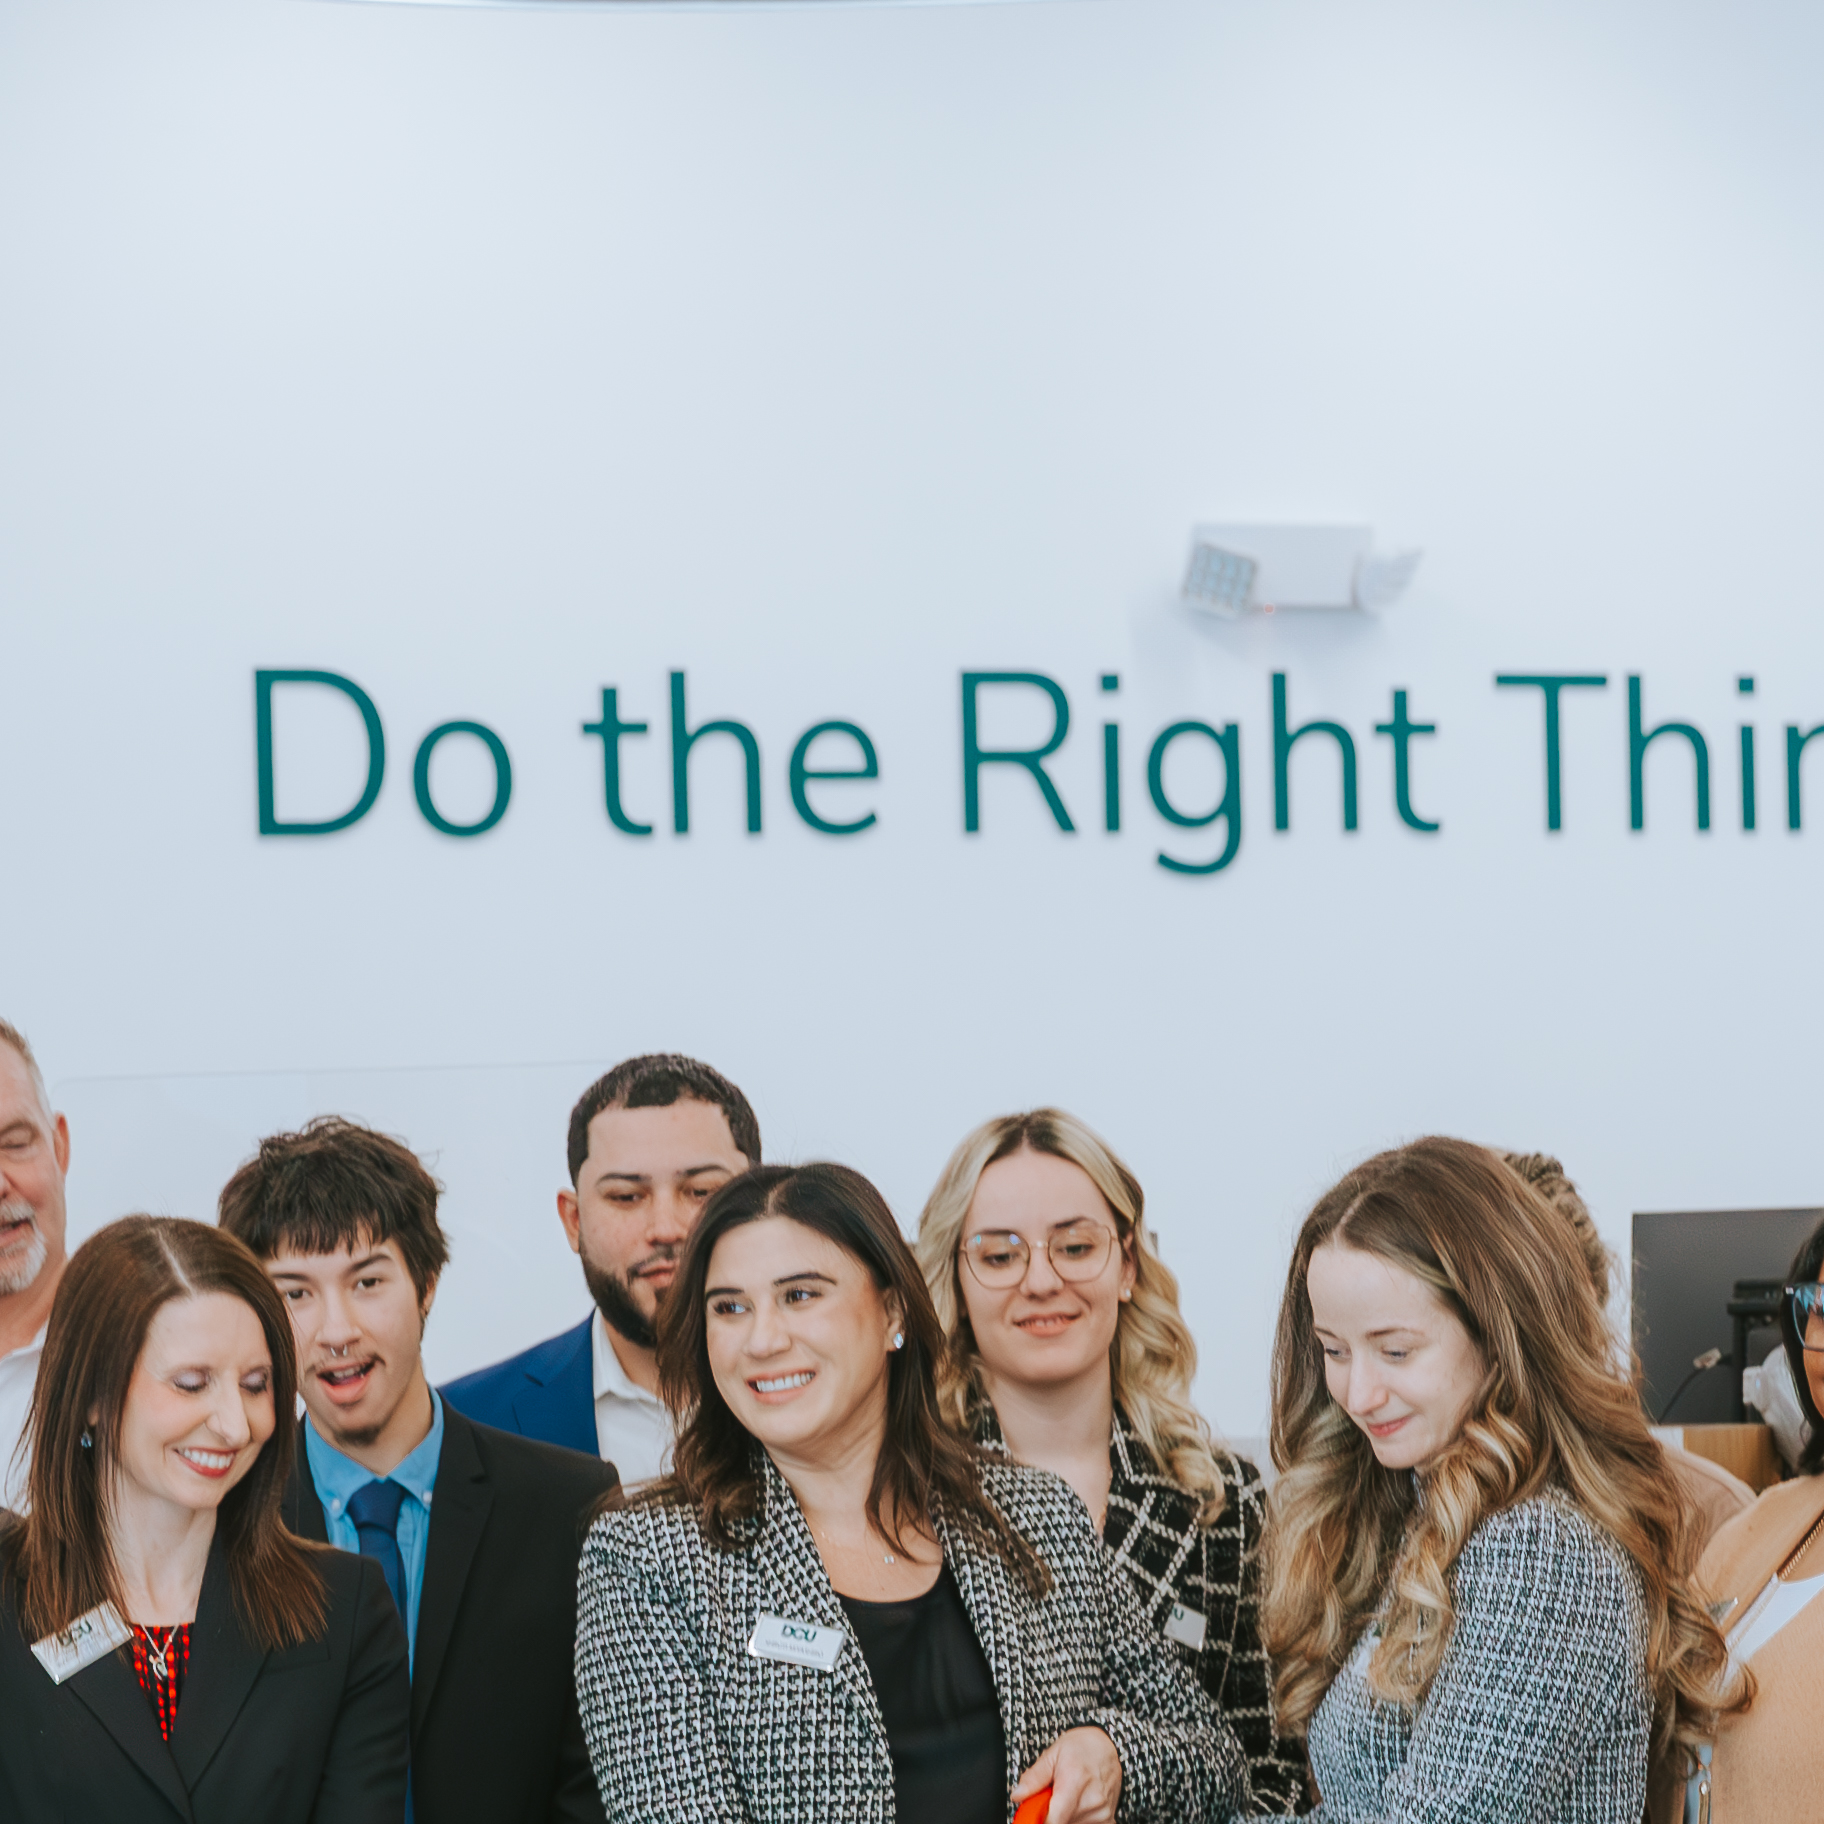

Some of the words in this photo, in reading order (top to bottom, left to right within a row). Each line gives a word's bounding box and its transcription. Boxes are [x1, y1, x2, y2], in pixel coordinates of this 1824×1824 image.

[253, 667, 514, 840] Do
[581, 669, 880, 838] the
[960, 669, 1441, 877] Right
[782, 1624, 817, 1643] DCU
